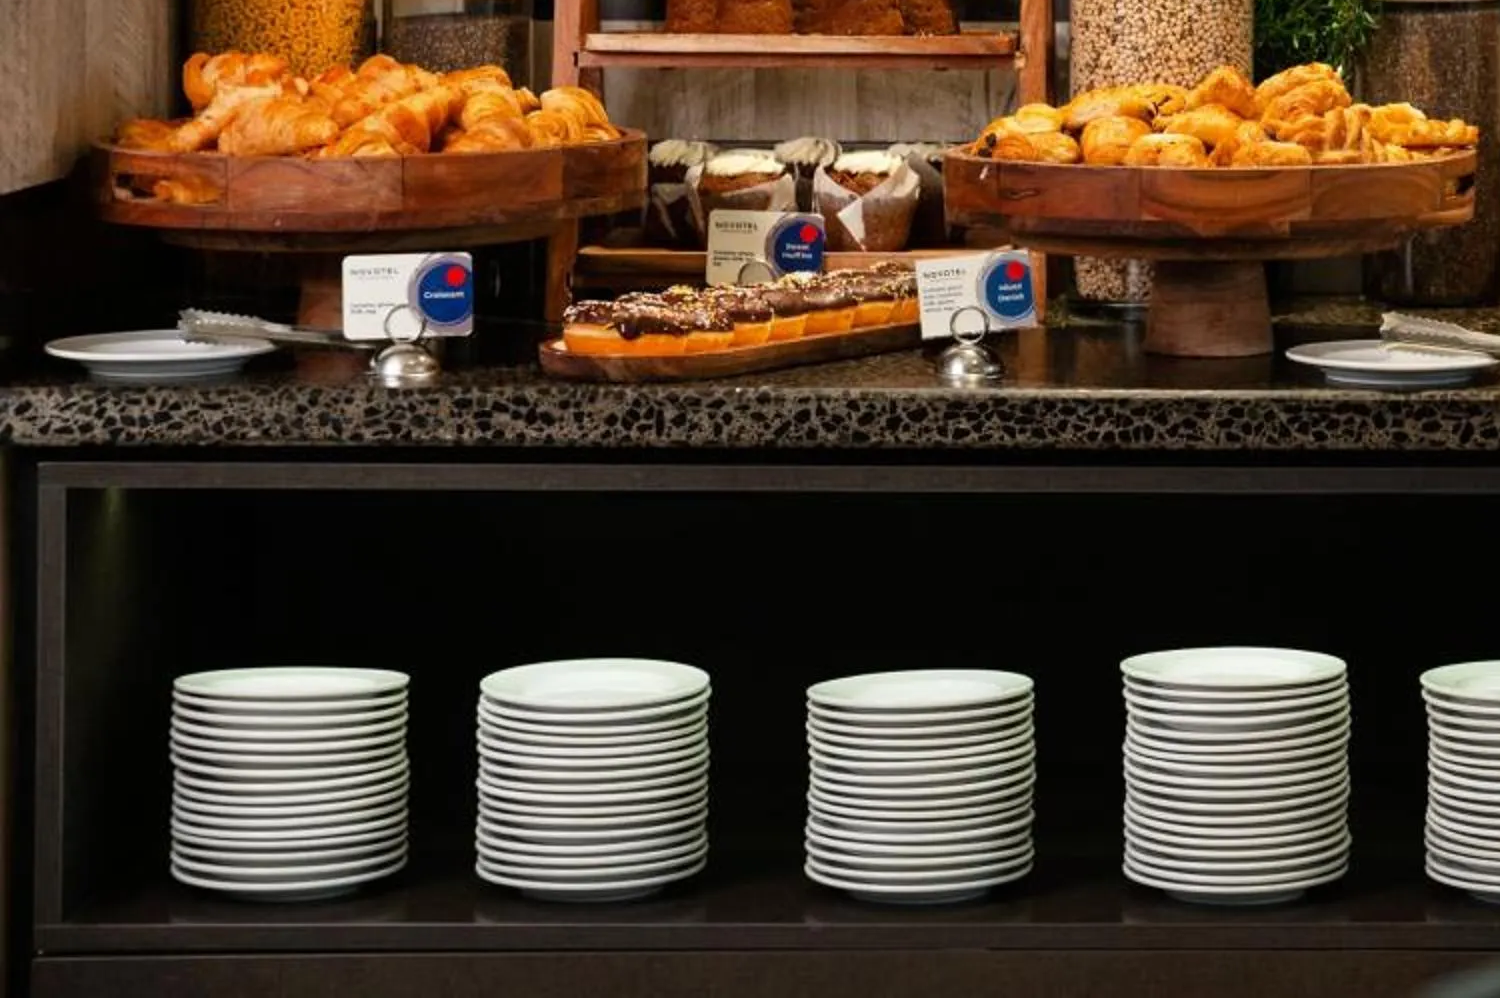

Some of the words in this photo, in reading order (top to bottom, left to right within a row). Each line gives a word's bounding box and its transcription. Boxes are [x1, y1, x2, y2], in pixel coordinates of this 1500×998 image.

[715, 221, 758, 231] NOVOTEL
[349, 267, 399, 276] NOVOTEL
[923, 268, 967, 279] NOVOTEL
